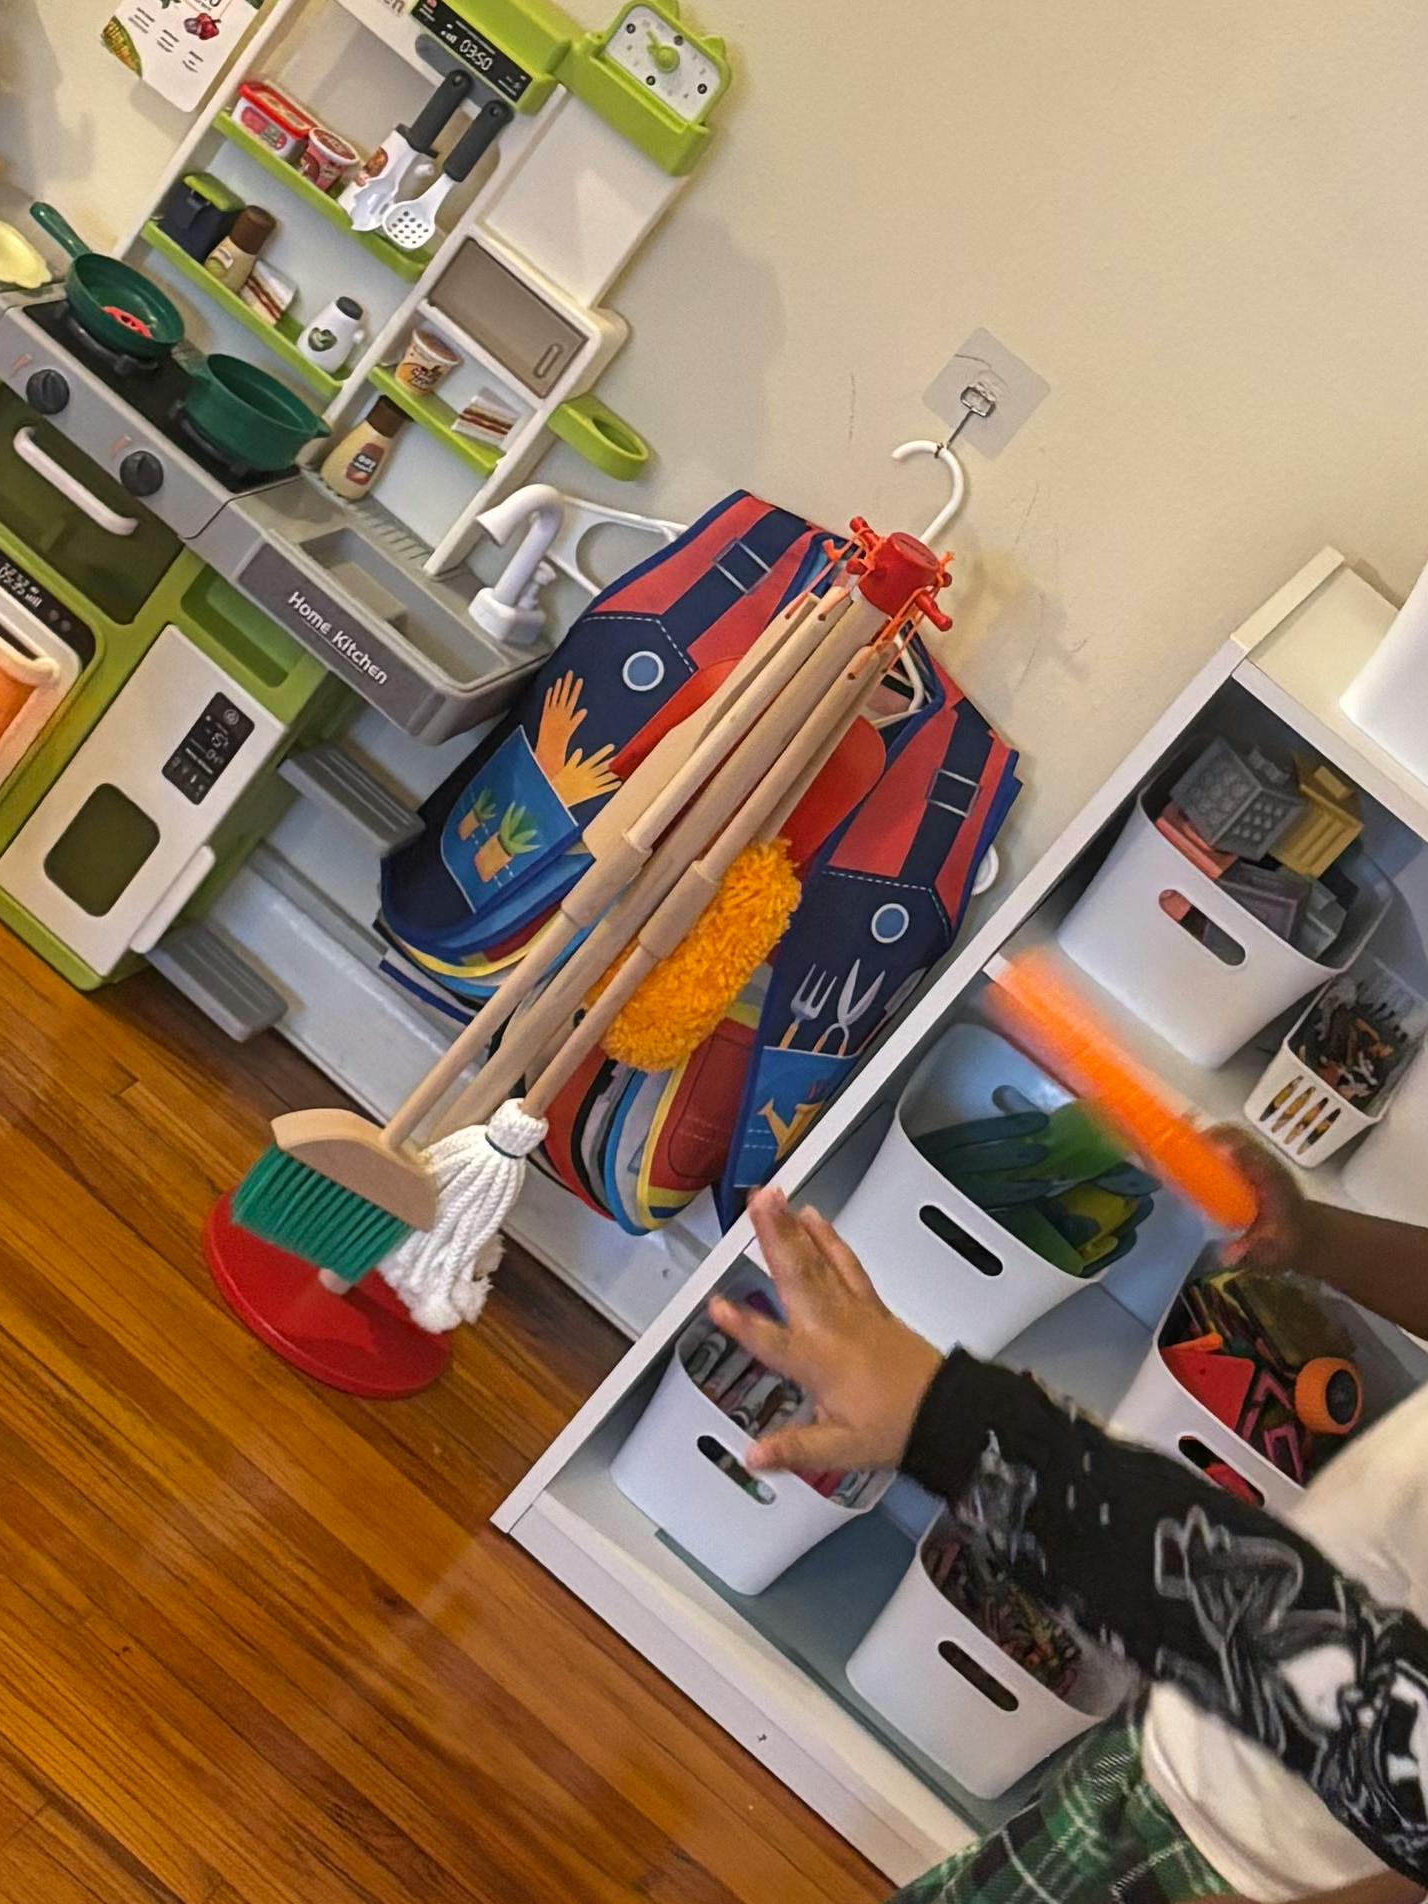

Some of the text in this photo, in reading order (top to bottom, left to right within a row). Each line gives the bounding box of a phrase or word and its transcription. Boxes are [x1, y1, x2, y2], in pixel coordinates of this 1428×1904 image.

[458, 38, 495, 72] 03:50
[288, 591, 387, 684] Home Kitchen
